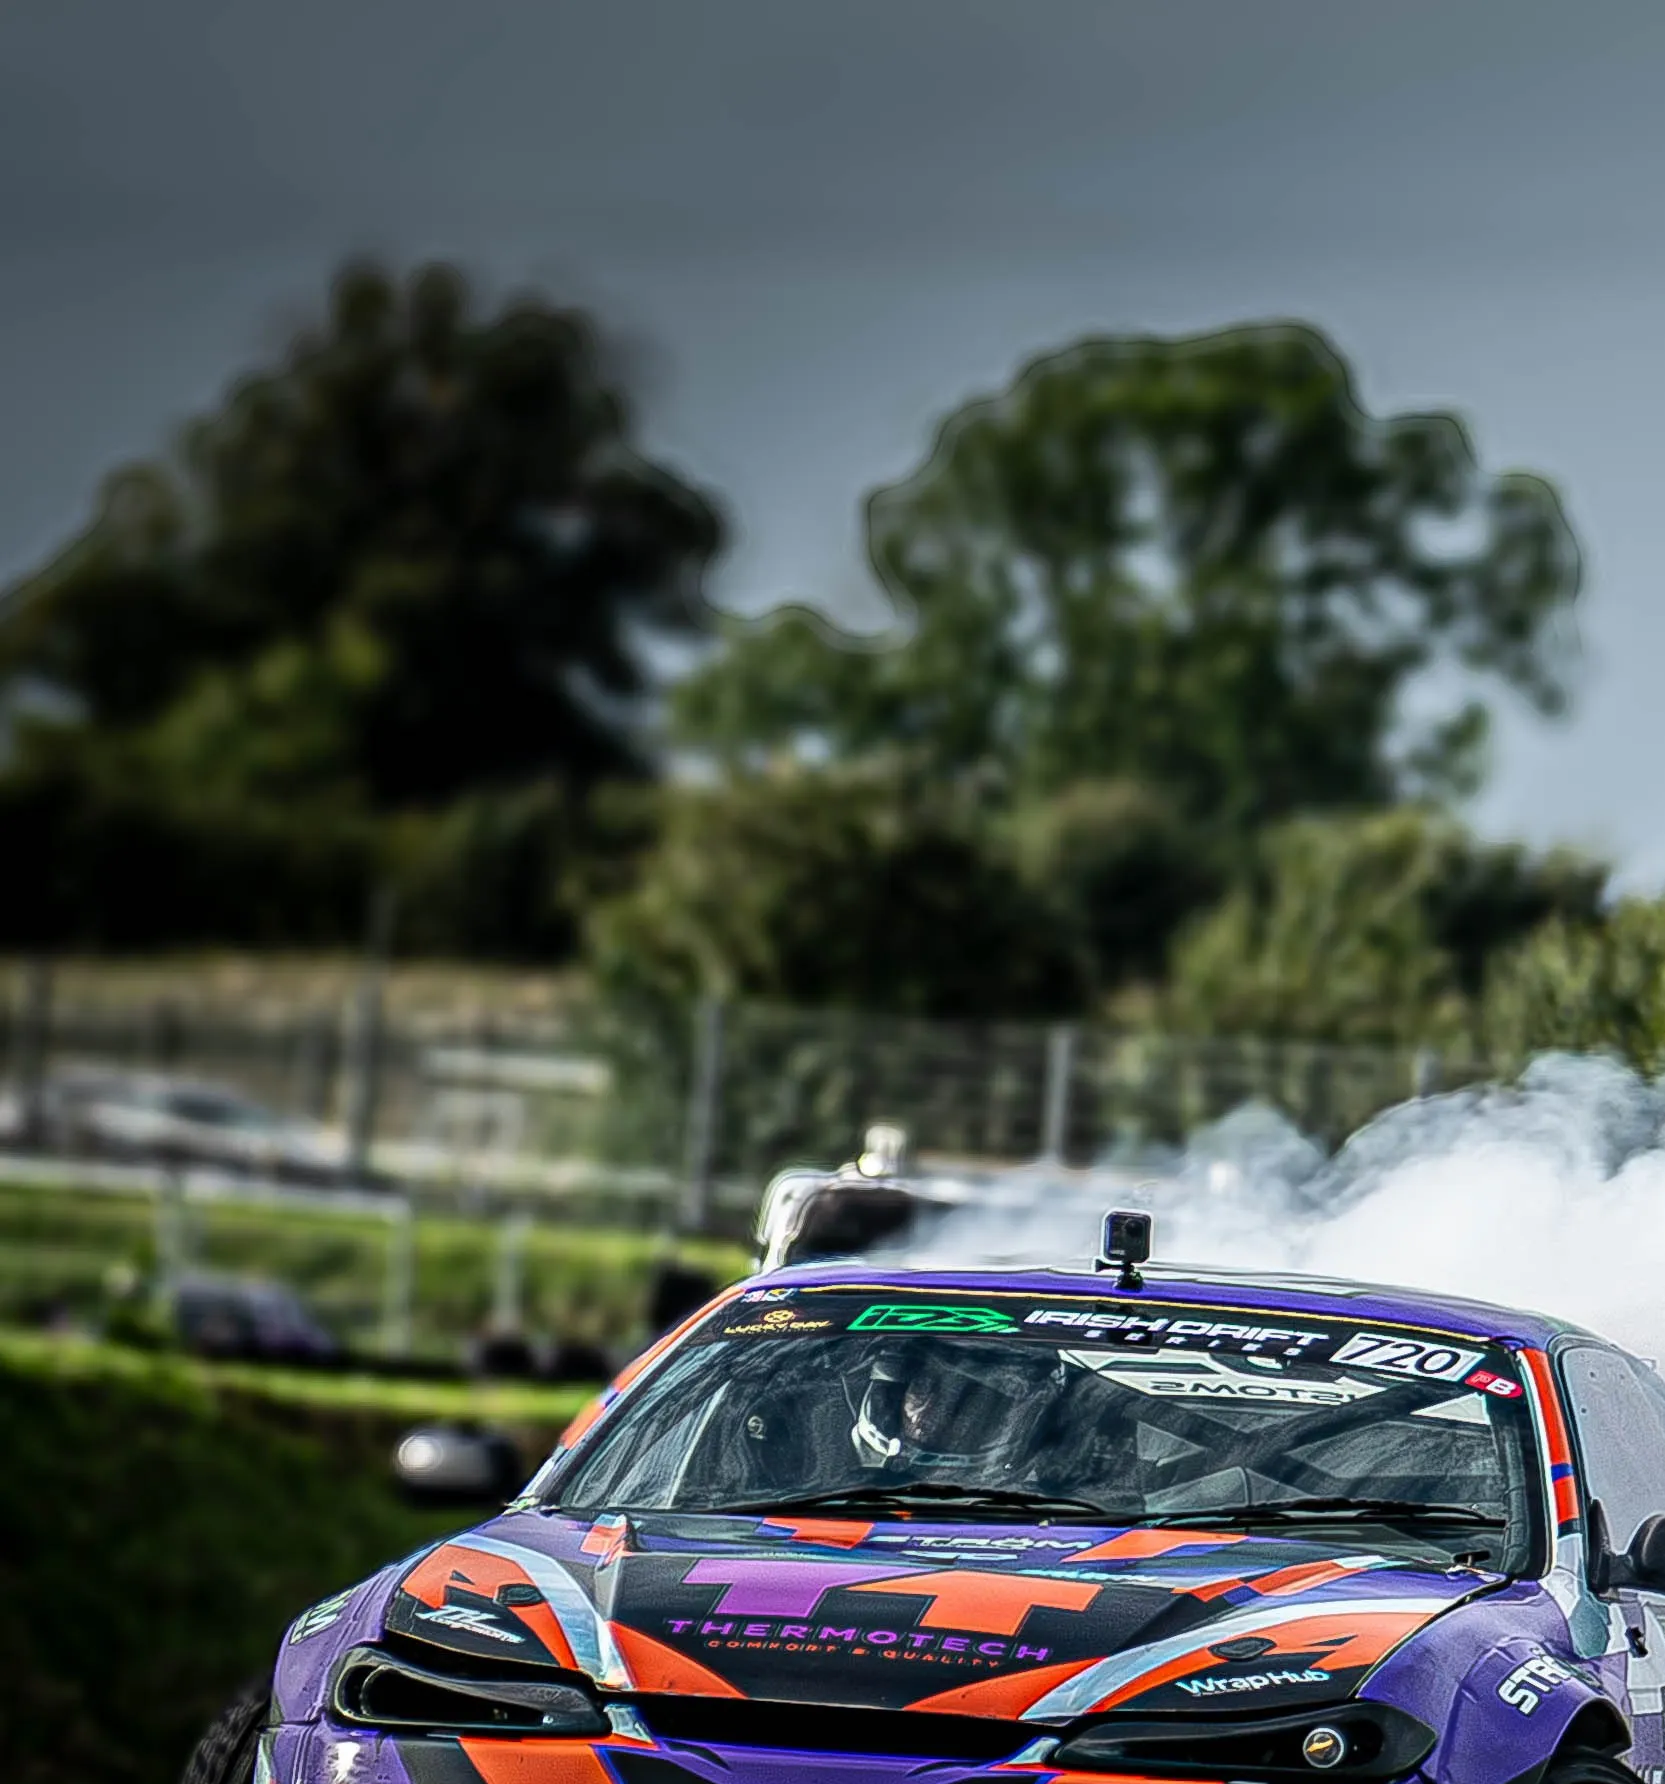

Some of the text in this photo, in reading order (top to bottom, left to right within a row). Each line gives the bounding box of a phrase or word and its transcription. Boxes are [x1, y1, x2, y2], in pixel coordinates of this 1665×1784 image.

[1024, 1310, 1330, 1345] IRISH DRIFT
[1084, 1329, 1304, 1356] SERIES
[1340, 1336, 1461, 1375] 720
[667, 1620, 1049, 1662] THERMOTECH
